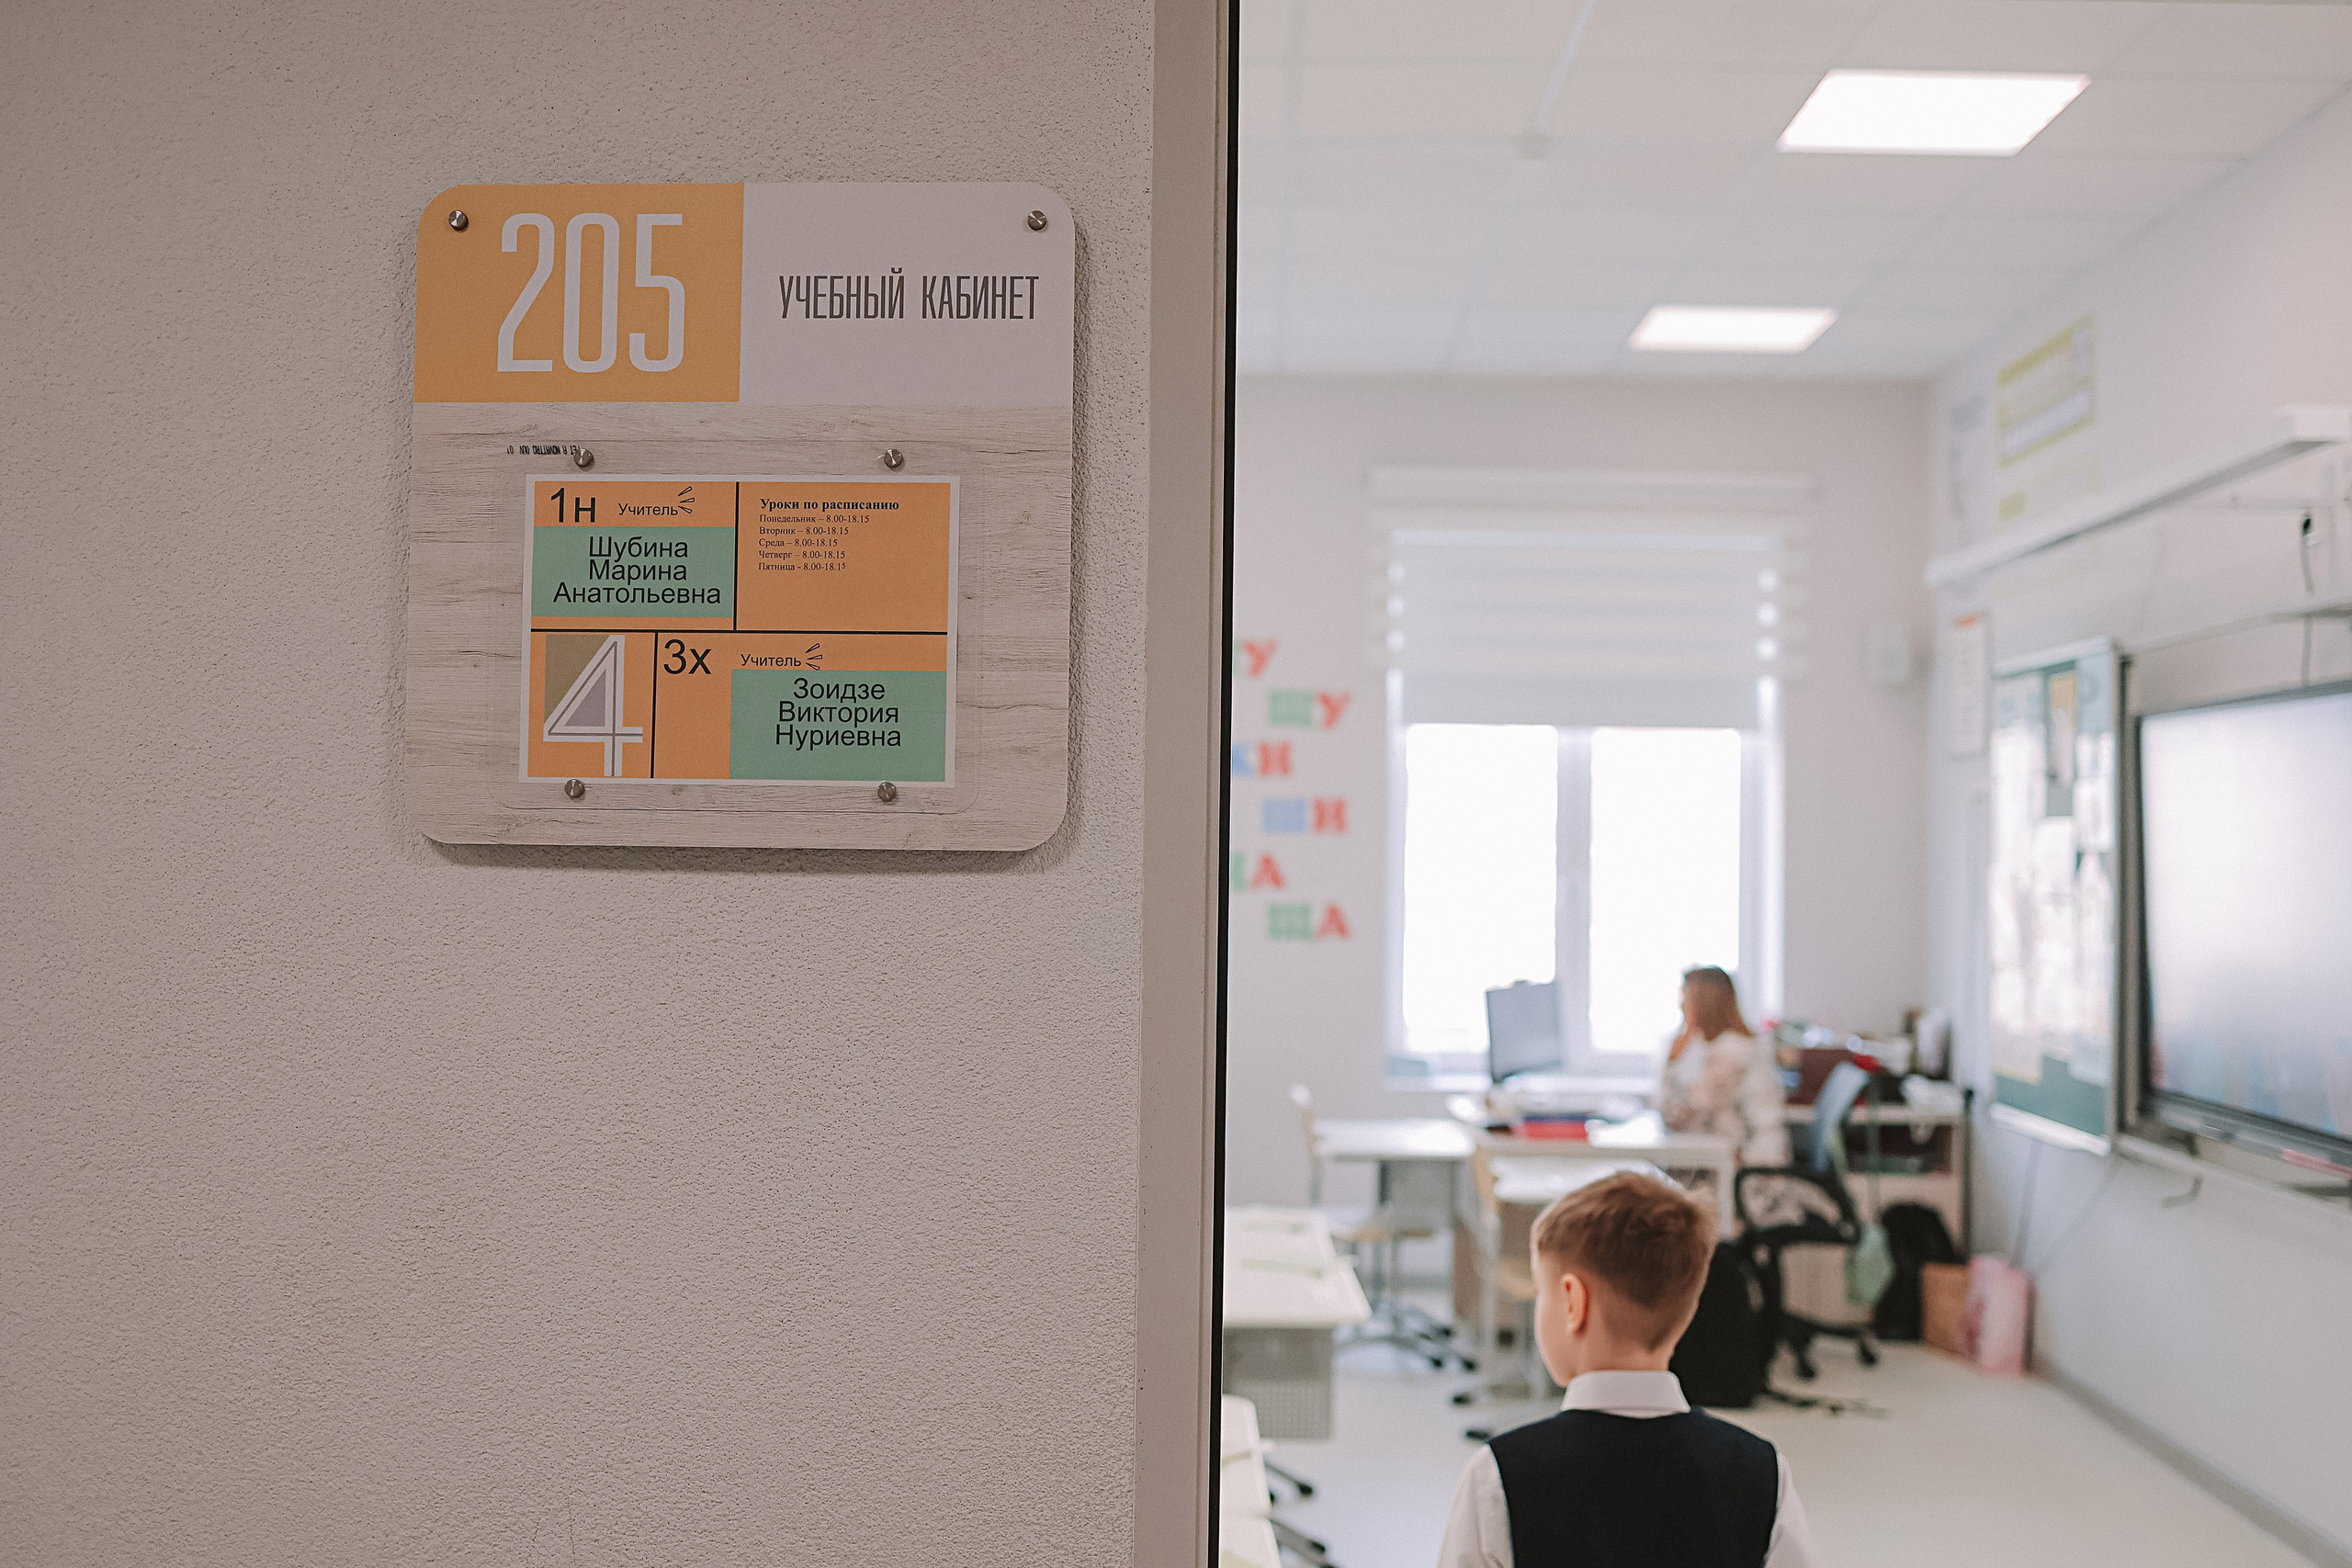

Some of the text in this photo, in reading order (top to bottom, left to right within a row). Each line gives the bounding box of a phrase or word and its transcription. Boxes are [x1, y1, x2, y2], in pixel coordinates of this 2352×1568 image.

[497, 212, 685, 373] 205
[779, 266, 1039, 320] УЧЕБНЫЙ КАБИНЕТ
[550, 487, 596, 524] 1н
[617, 502, 679, 516] Учитель
[759, 513, 817, 525] Понедельник
[826, 514, 870, 524] 8.00-18.15
[760, 498, 899, 513] Уроки по расписанию
[758, 538, 785, 547] Среда
[795, 538, 838, 547] 8.00-18.15
[759, 526, 797, 536] Вторник
[805, 526, 849, 536] 8.00-18.15
[588, 536, 689, 563] Шубина
[758, 550, 792, 560] Четверг
[802, 550, 845, 559] 8.00-18.15
[588, 558, 688, 585] Марина
[758, 562, 796, 572] Пятница
[803, 562, 846, 571] 8.00-18.15
[552, 581, 721, 604] Анатольевна
[663, 638, 713, 675] 3х
[741, 653, 802, 667] Учитель
[793, 677, 886, 704] Зоидзе
[543, 635, 643, 777] 4
[779, 700, 899, 728] Виктория
[775, 723, 901, 751] Нуриевна
